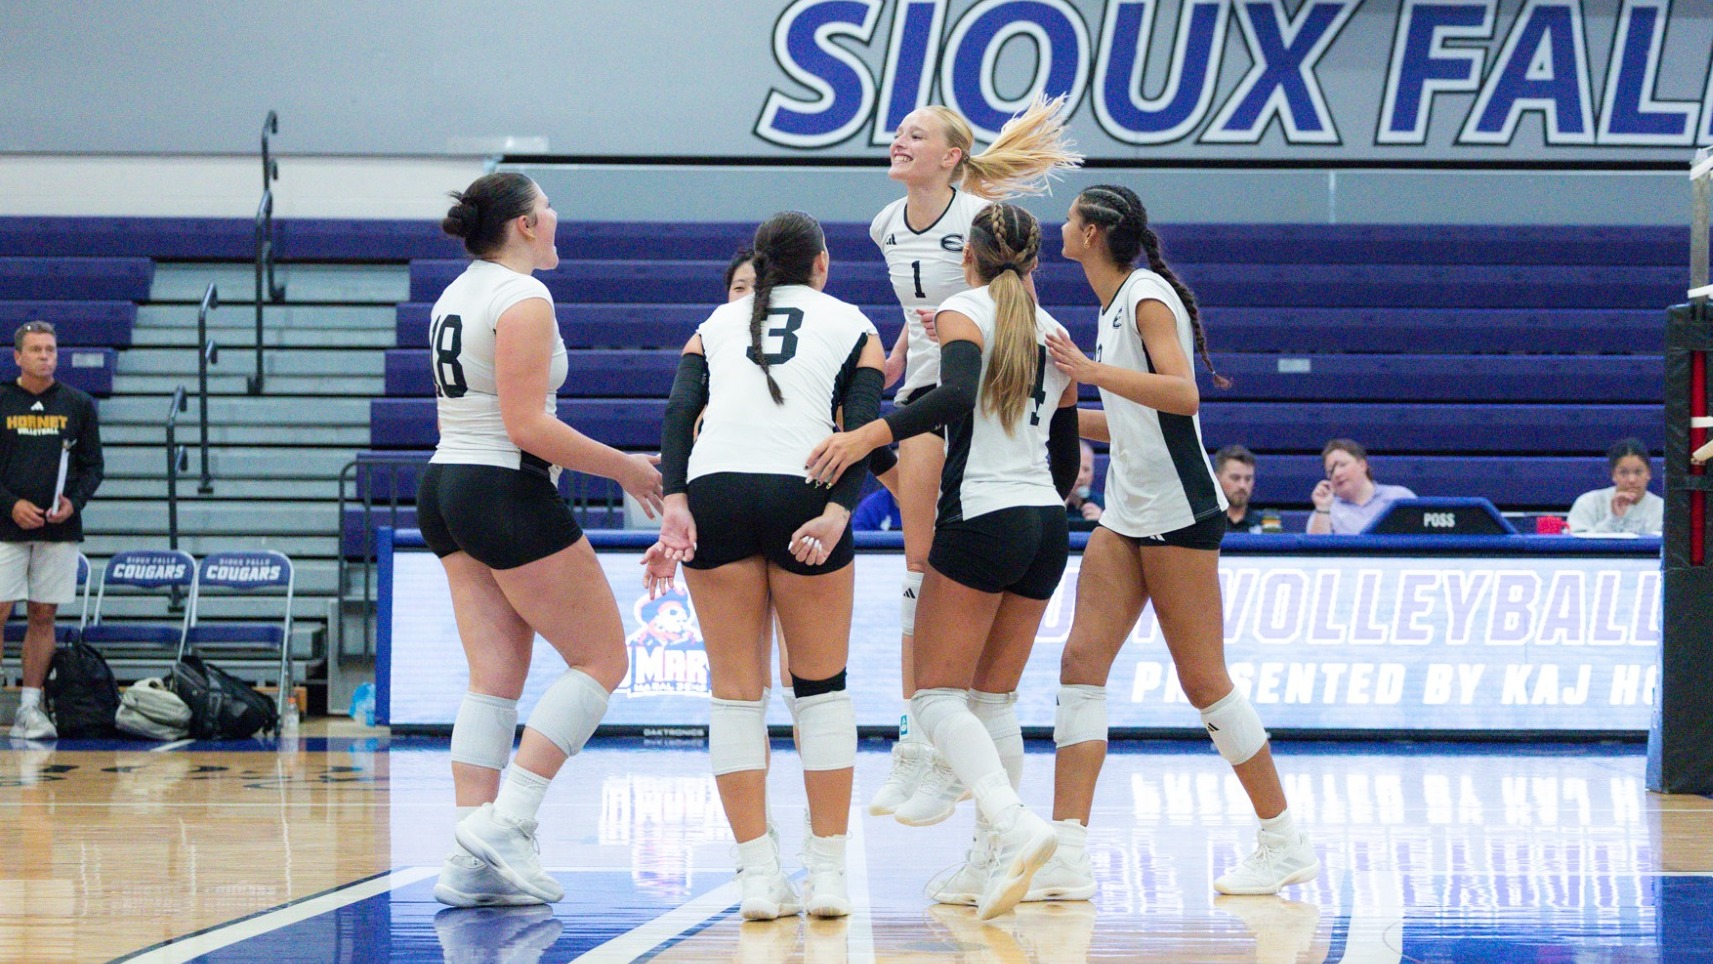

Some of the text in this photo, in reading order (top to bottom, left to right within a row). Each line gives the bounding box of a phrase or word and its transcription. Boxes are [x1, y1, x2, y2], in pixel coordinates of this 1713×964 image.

[754, 0, 1713, 147] SIOUX FAL
[911, 260, 926, 298] 1
[746, 307, 804, 365] 3
[6, 415, 68, 430] HORNET
[1423, 512, 1456, 528] POSS
[112, 563, 187, 579] COUGARS
[205, 565, 281, 581] COUGARS
[1131, 661, 1406, 704] PSENTED
[1422, 663, 1486, 704] BY
[1500, 664, 1592, 705] KAJ
